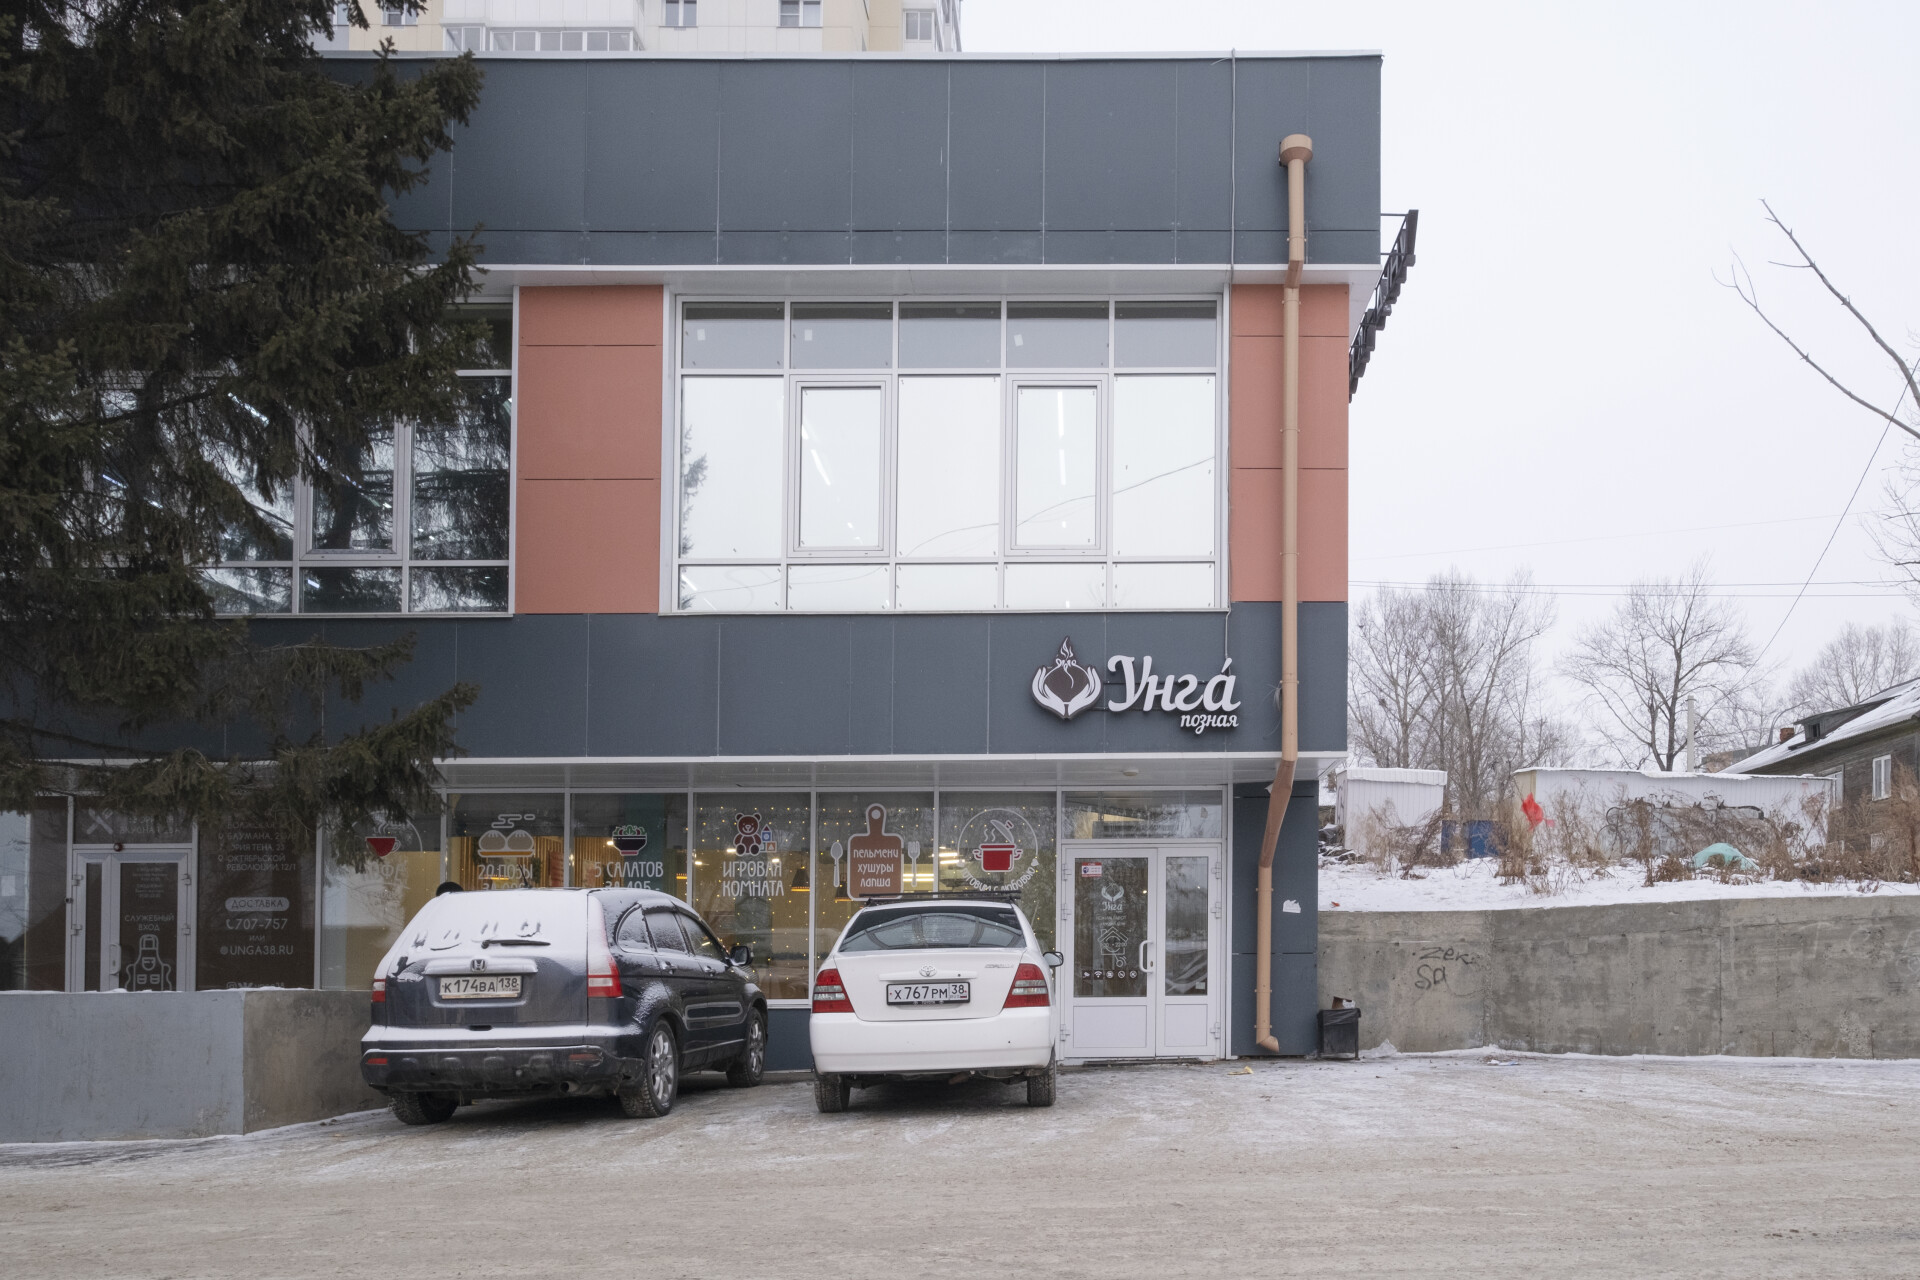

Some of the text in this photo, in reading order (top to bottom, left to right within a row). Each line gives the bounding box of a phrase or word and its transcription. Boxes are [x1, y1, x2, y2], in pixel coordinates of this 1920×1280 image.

[1180, 713, 1239, 735] позная
[227, 853, 286, 863] ОКТЯБРЬСКОЙ
[853, 848, 899, 859] пельмени
[281, 863, 297, 871] 12/1
[478, 864, 495, 880] 20
[594, 861, 664, 878] 5 САЛАТОВ
[722, 861, 783, 878] ИГРОВАЯ
[857, 863, 894, 875] хушуры
[860, 877, 891, 888] лапша
[722, 880, 785, 897] КОМНАТА
[231, 899, 283, 910] ДОСТАВКА
[124, 912, 175, 922] СЛУЖЕБНЫЙ
[138, 923, 161, 932] ВХОД
[234, 918, 288, 930] 707-757
[230, 945, 294, 956] UNGA38.RU
[444, 977, 518, 993] К174ВА 138
[951, 984, 965, 995] 38
